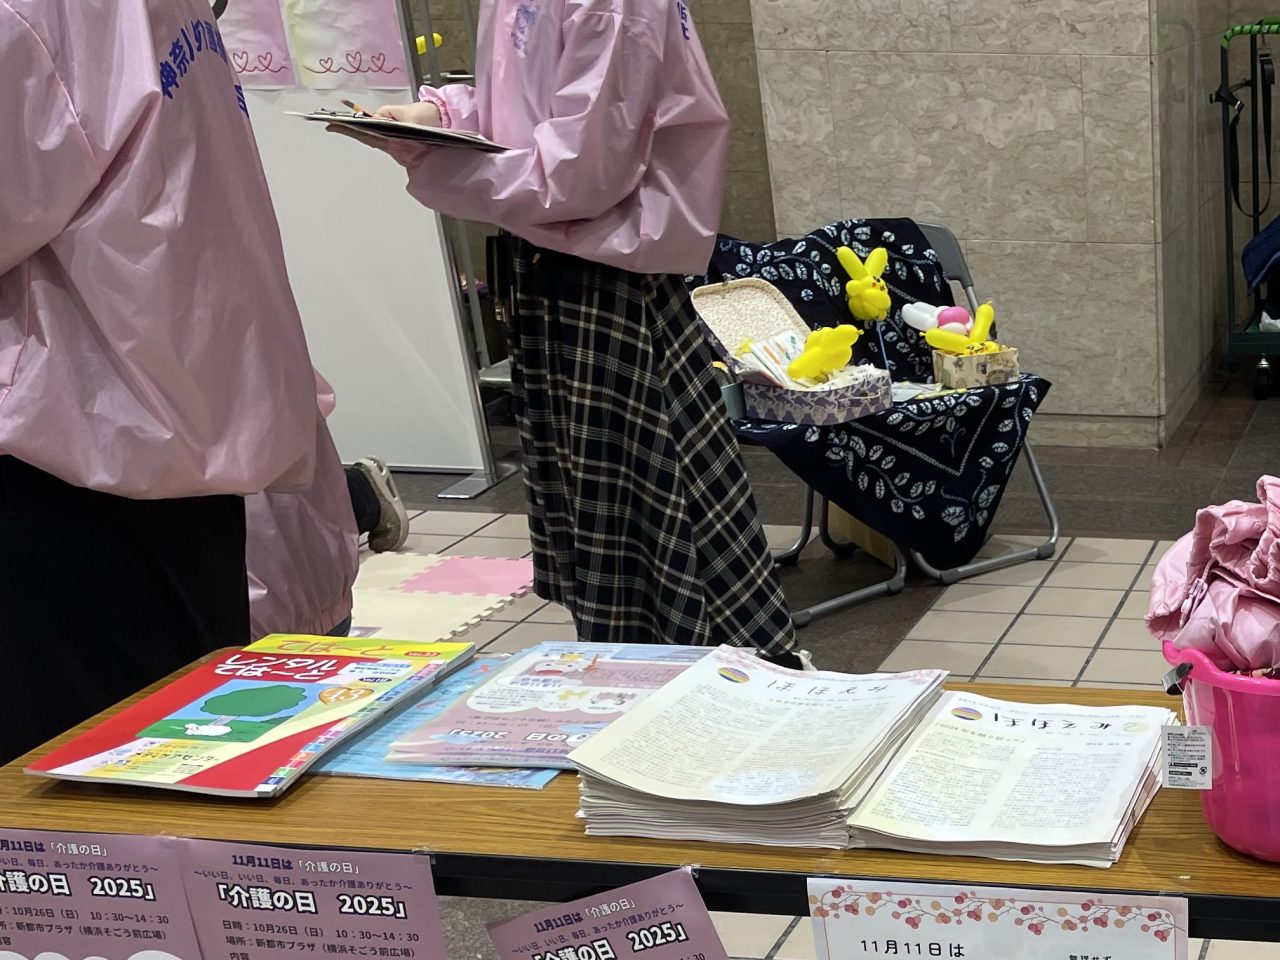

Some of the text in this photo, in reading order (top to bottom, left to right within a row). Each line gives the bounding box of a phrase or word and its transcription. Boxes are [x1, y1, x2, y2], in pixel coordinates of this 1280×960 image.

[225, 653, 339, 670] レンタル
[766, 678, 889, 697] ほほえみ
[993, 711, 1113, 731] ほほえみ
[0, 857, 159, 873] い日、毎日、あったか介護ありがとう～
[0, 870, 72, 897] 護の日
[216, 882, 408, 920] 「介護の日 2025」
[0, 907, 80, 920] ：10月26日（日）
[626, 921, 690, 952] 2025」
[860, 939, 966, 959] 11月11日は
